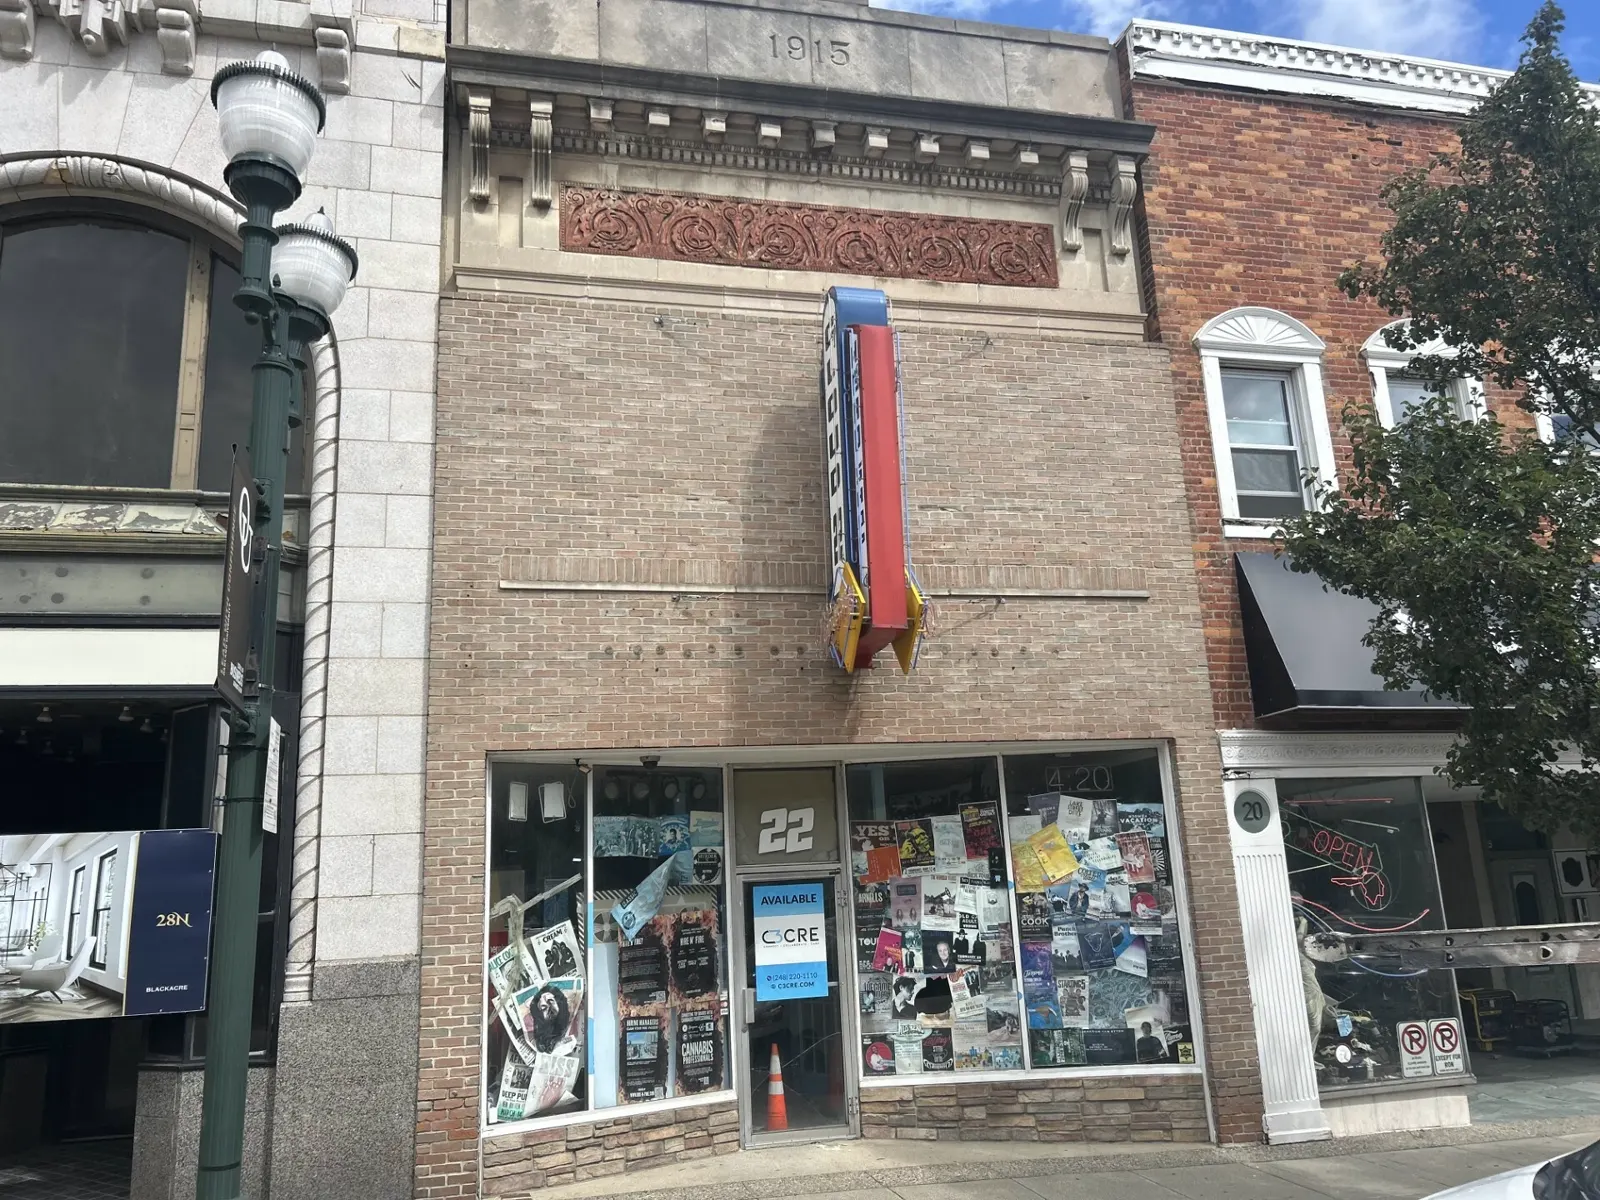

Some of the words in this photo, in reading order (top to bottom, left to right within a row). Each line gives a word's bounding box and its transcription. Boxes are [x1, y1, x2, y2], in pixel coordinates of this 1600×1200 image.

[768, 34, 850, 66] 1915
[1242, 801, 1264, 821] 20
[758, 807, 814, 854] 22
[855, 825, 889, 836] YES
[1313, 830, 1373, 874] OPEN
[761, 893, 817, 905] AVAILABLE
[156, 911, 193, 928] 28N
[542, 928, 563, 943] CREAM
[762, 927, 819, 944] C3CRE
[859, 937, 877, 946] TOU
[788, 972, 818, 981] 220-1110
[146, 985, 188, 993] BLACKACRE
[681, 1040, 713, 1056] CANNABIS
[683, 1054, 714, 1065] PROFESSIONALS
